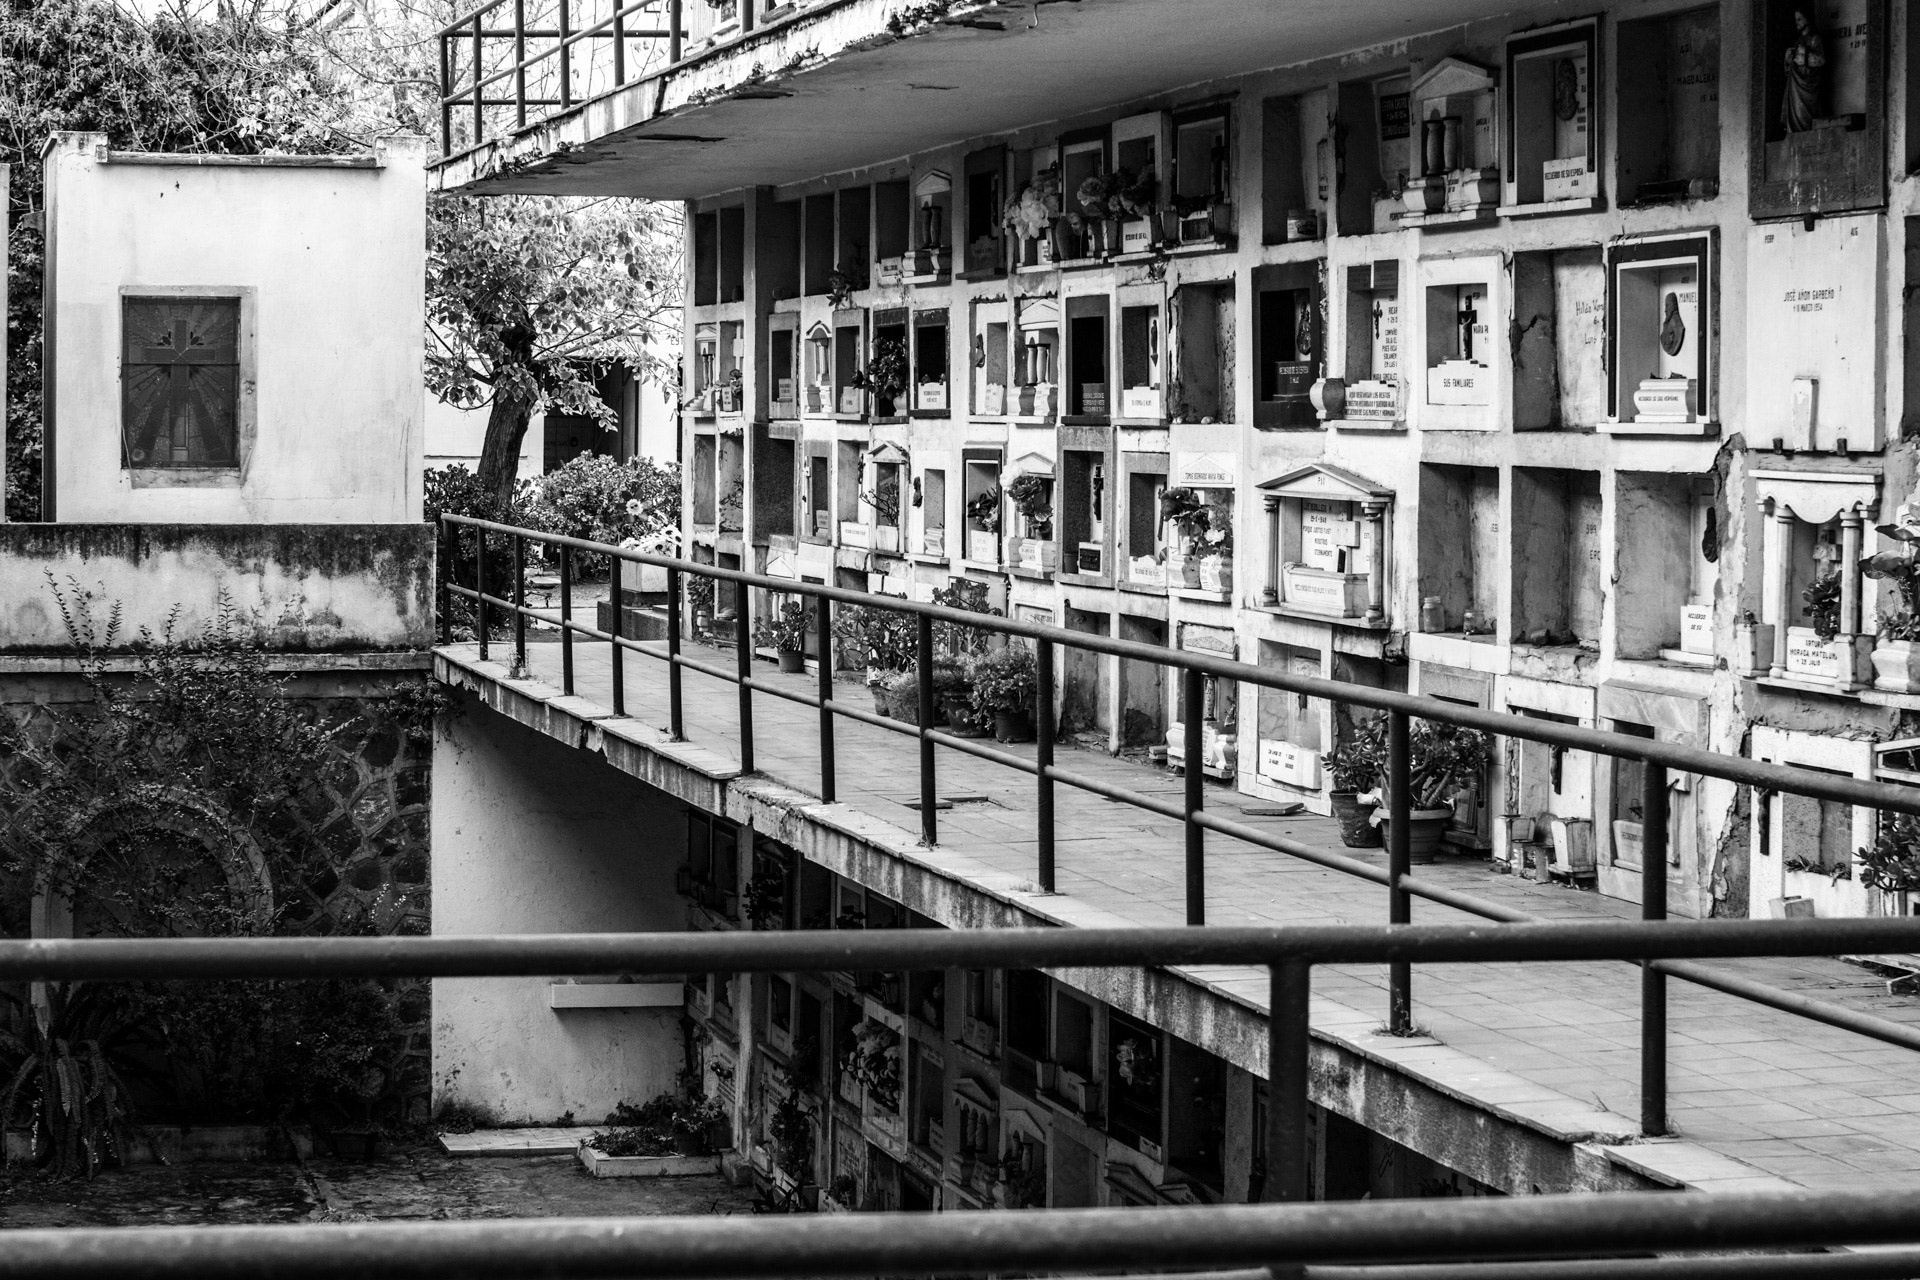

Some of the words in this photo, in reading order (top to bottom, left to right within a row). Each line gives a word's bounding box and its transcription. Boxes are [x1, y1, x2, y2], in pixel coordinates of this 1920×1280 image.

[1679, 292, 1698, 303] MANUEL
[1443, 378, 1451, 388] SUS
[1452, 378, 1474, 388] FAMILIARES
[1805, 639, 1823, 649] ARTURO
